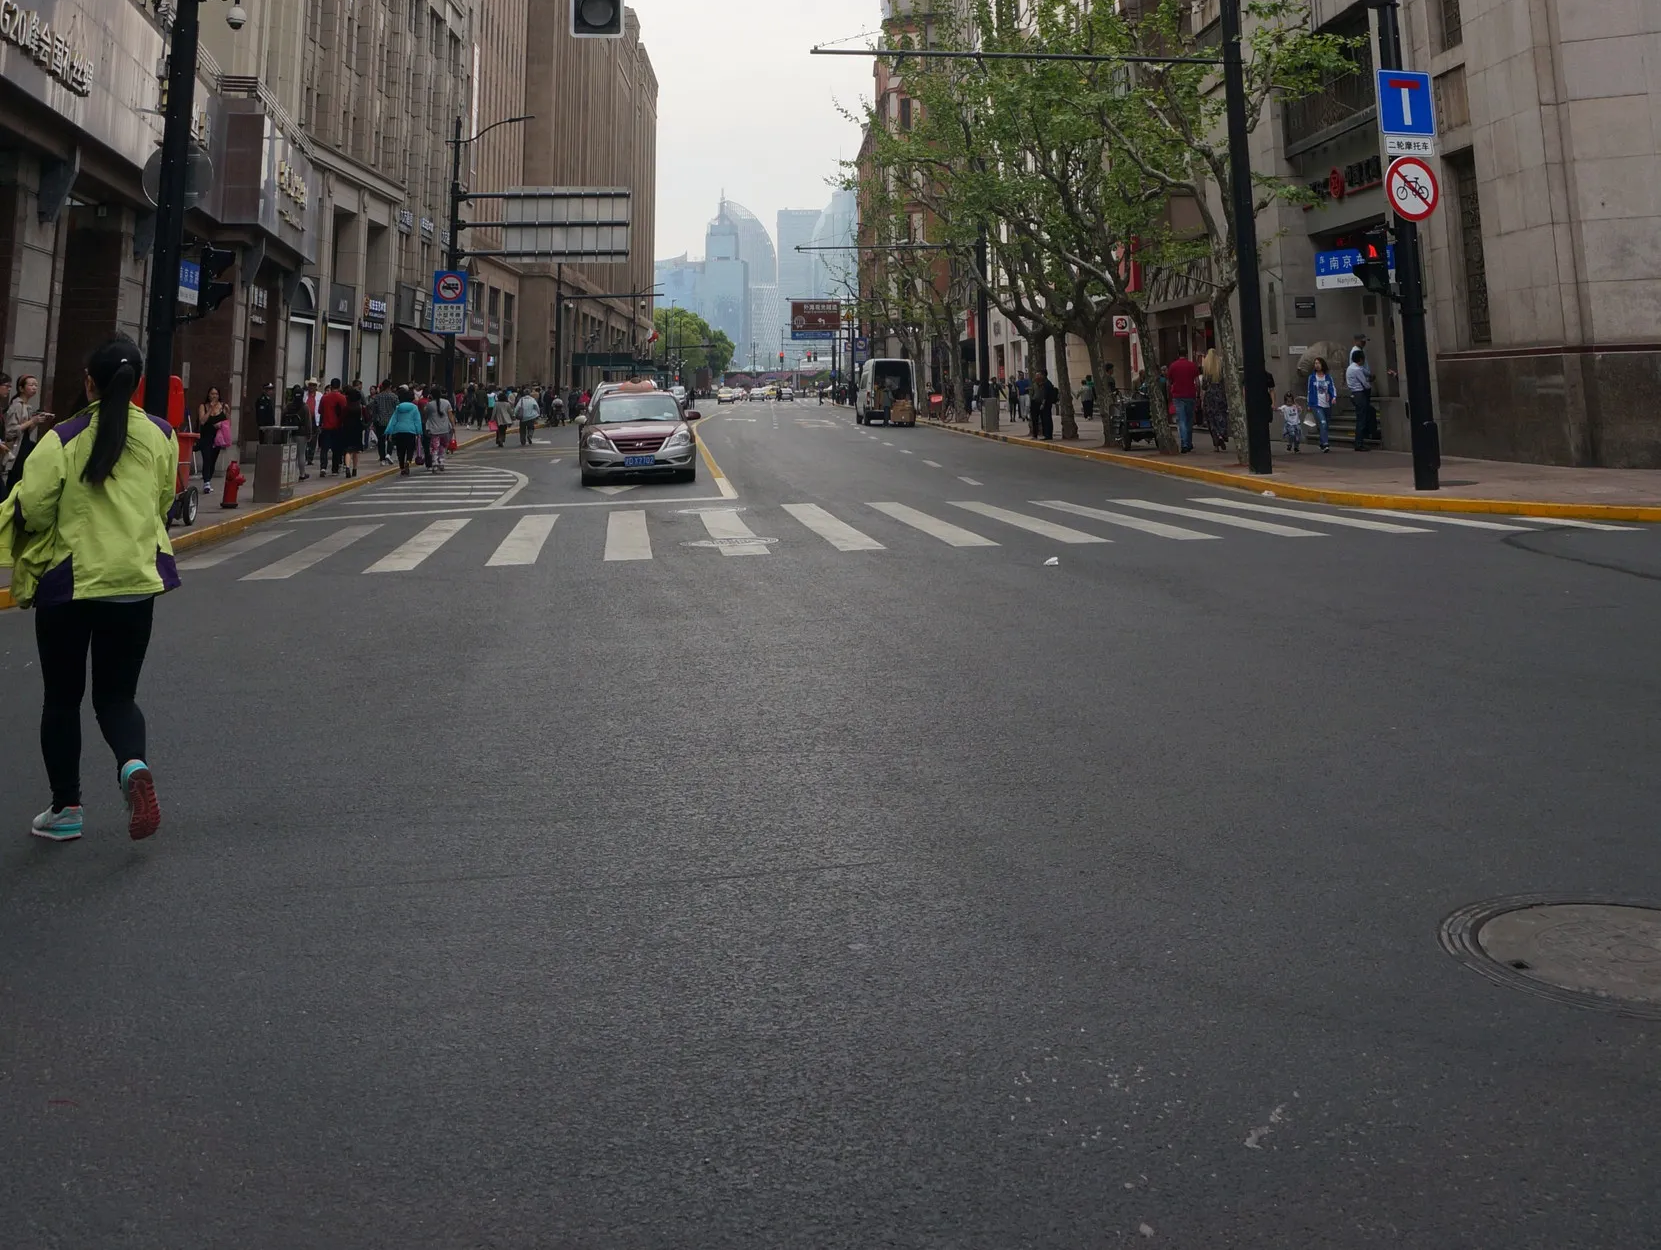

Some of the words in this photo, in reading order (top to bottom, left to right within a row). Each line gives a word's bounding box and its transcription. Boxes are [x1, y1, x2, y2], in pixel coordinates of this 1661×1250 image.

[1388, 141, 1429, 151] 二轮摩托车
[1336, 276, 1358, 286] Nanjing
